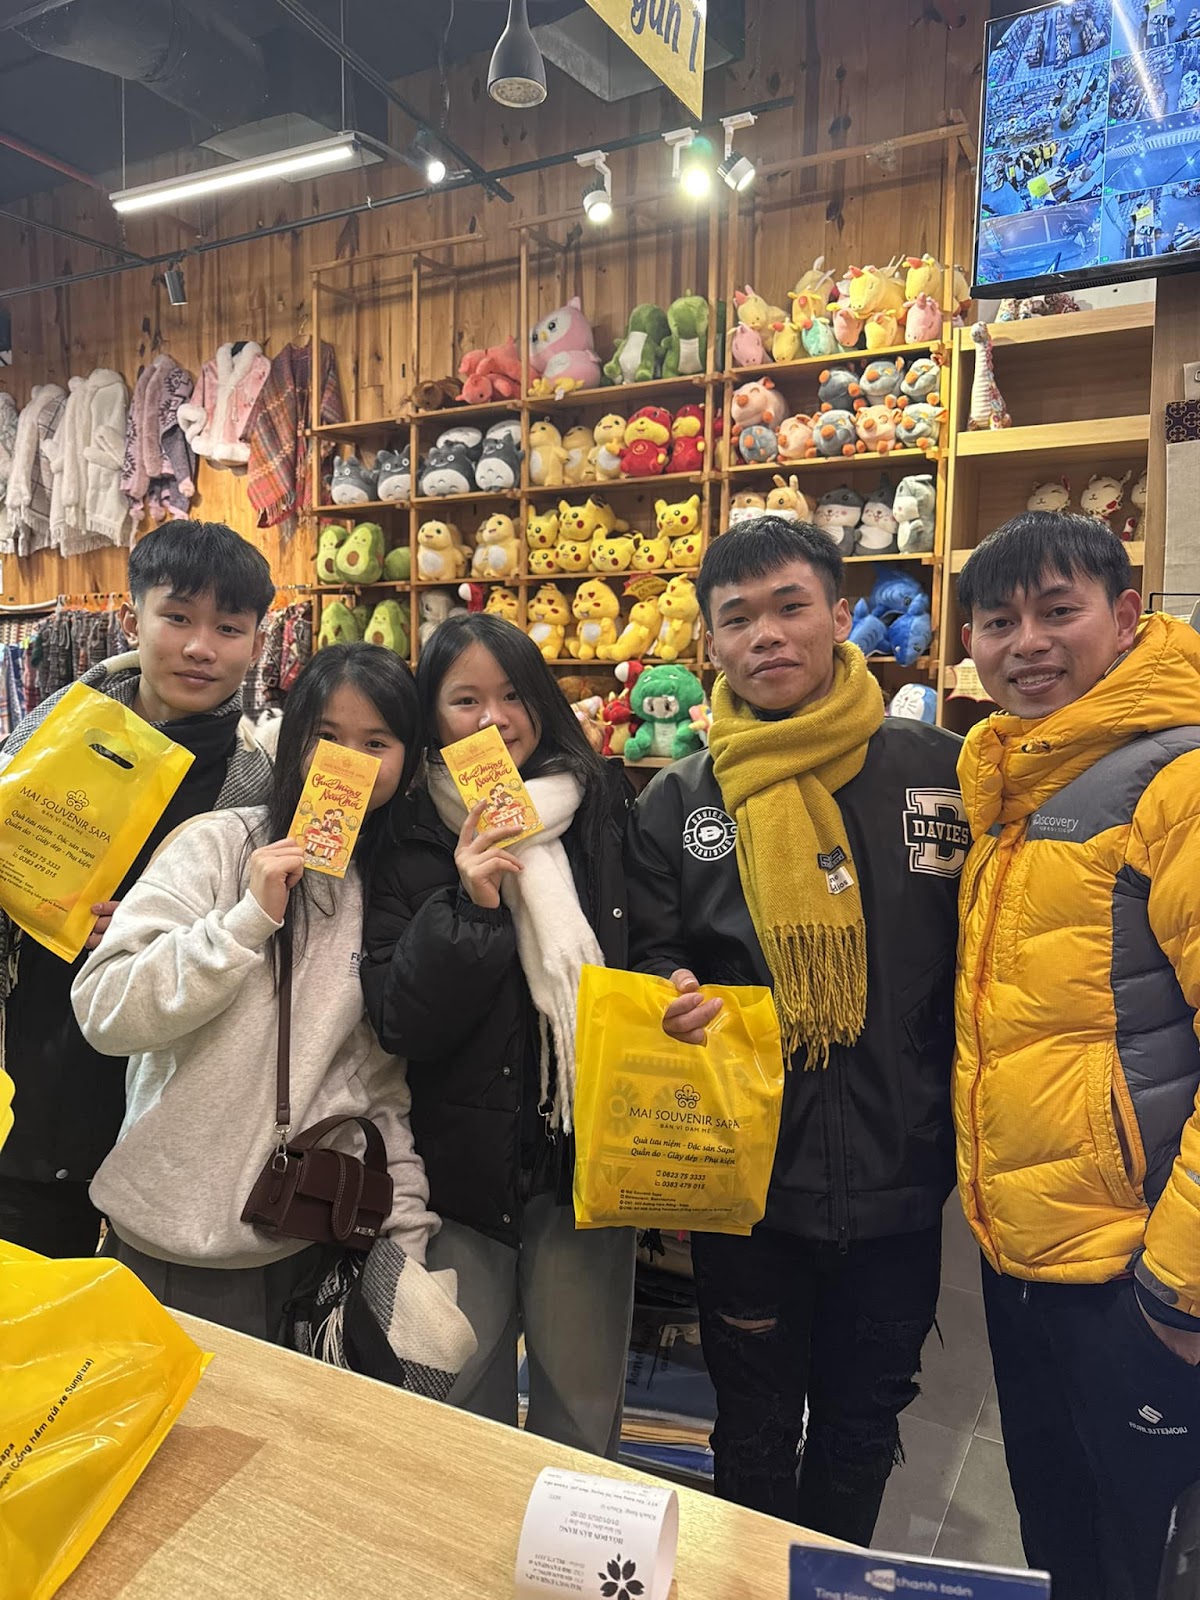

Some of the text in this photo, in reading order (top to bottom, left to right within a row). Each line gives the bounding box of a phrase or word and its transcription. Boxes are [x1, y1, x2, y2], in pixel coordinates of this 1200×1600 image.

[20, 786, 111, 843] MAI SOUVENIR SAPA
[912, 820, 970, 845] DAVIES
[79, 847, 96, 860] Sapa
[19, 855, 34, 866] 0383
[34, 863, 45, 872] 479
[45, 869, 58, 878] 015
[629, 1107, 740, 1130] MAI SOUVENIR SAPA
[717, 1146, 736, 1154] Sapa
[662, 1170, 679, 1178] 0823
[662, 1180, 678, 1188] 0383
[692, 1182, 706, 1190] 015
[58, 1395, 68, 1407] xe
[896, 1577, 938, 1592] thanh
[940, 1583, 973, 1598] toán
